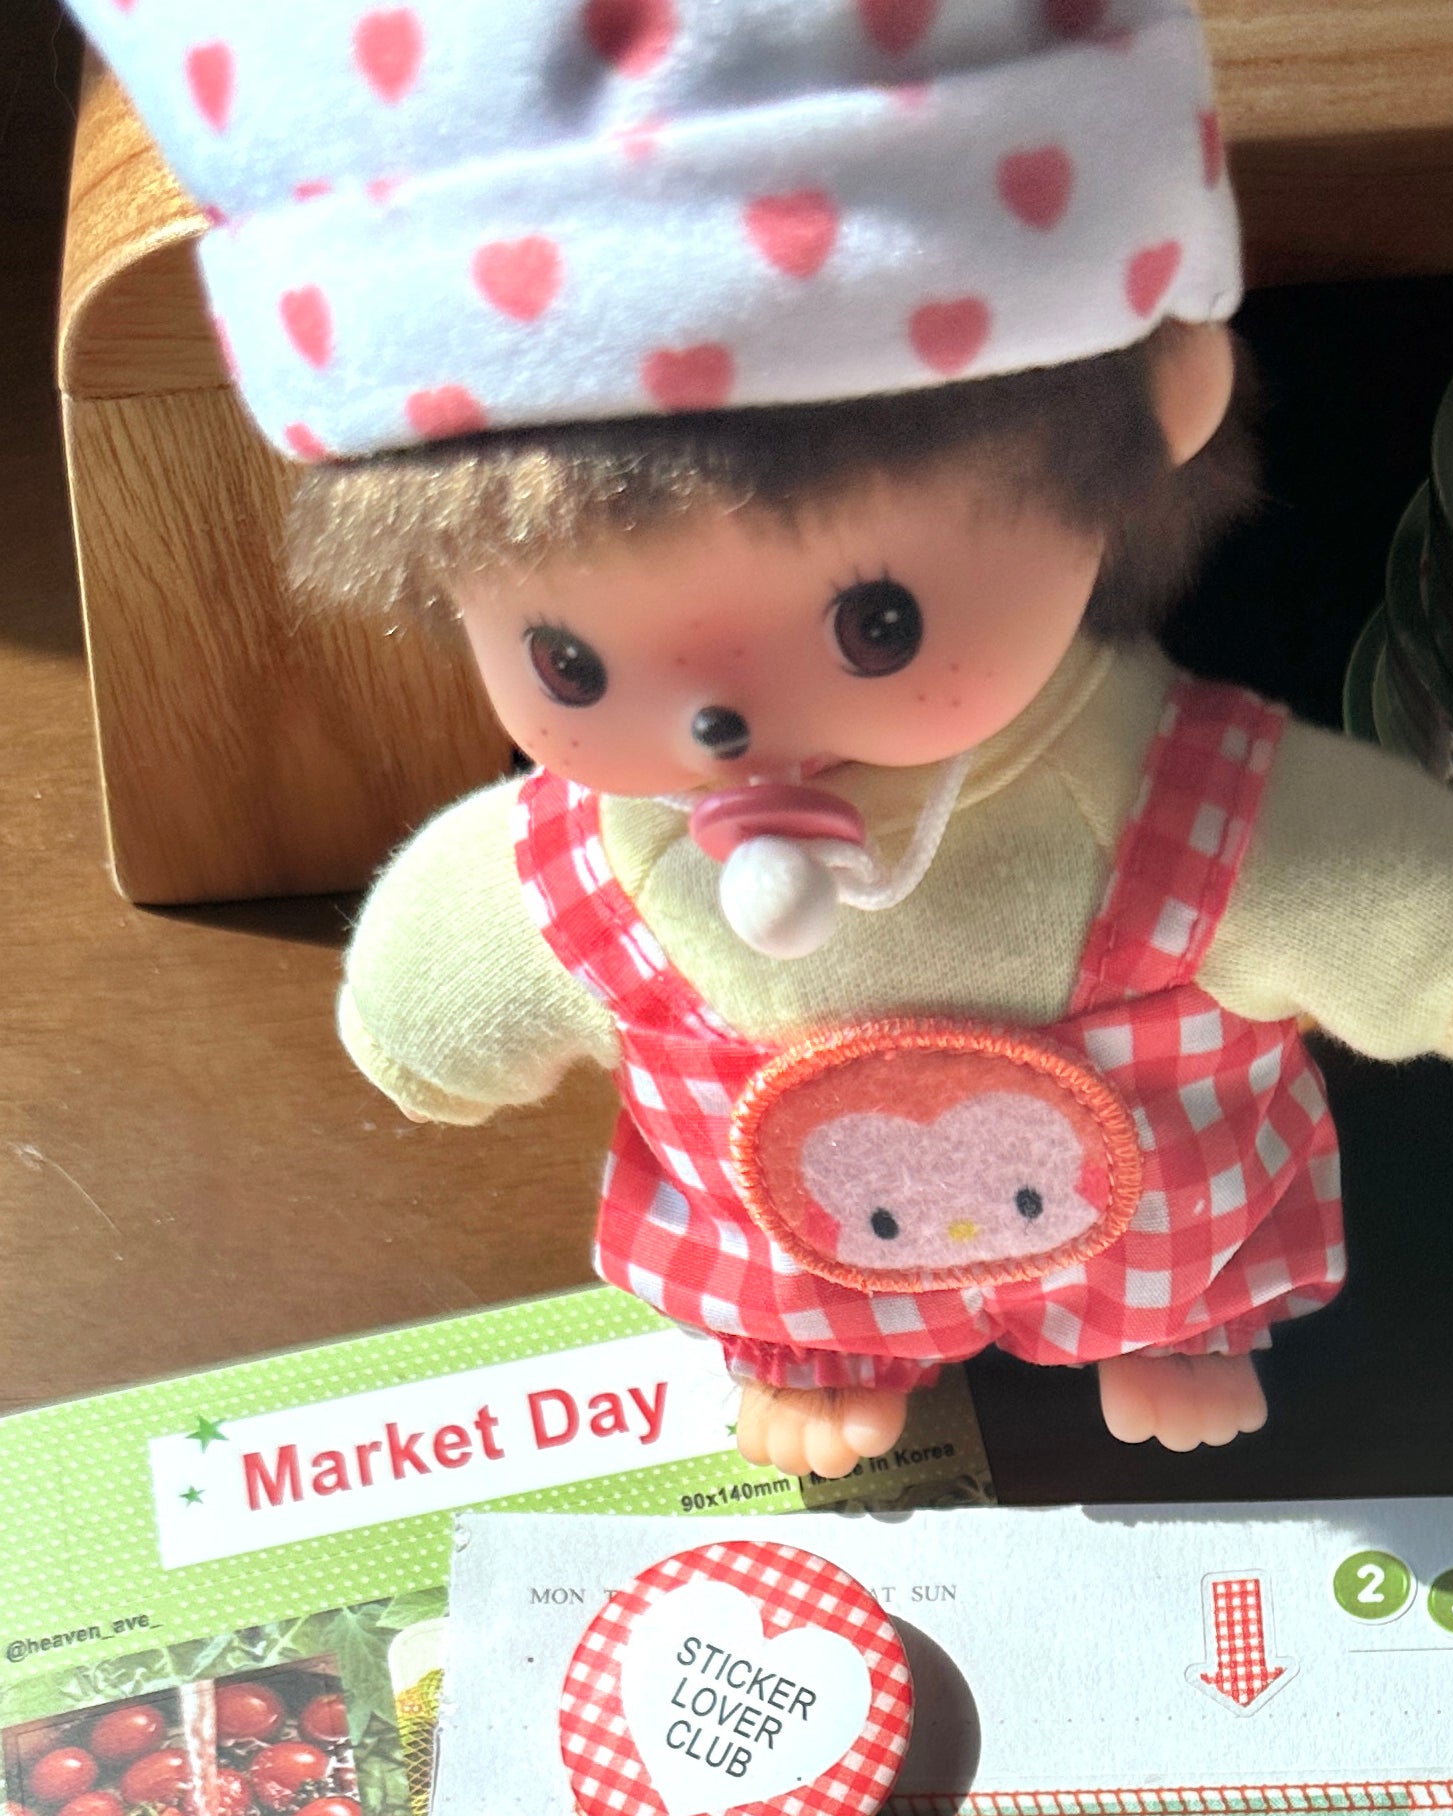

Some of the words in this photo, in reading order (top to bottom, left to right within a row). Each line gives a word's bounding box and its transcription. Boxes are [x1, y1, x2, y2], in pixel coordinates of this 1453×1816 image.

[243, 1405, 505, 1511] Market
[526, 1381, 669, 1450] Day
[681, 1475, 790, 1513] 90x140mm
[870, 1457, 888, 1474] in
[899, 1443, 956, 1465] Korea
[530, 1587, 585, 1604] MON
[912, 1585, 957, 1602] SUN
[1357, 1564, 1384, 1603] 2
[6, 1614, 163, 1662] @heaven_ave_
[677, 1637, 816, 1721] STICKER
[671, 1677, 782, 1749] LOVER
[666, 1720, 752, 1778] CLUB
